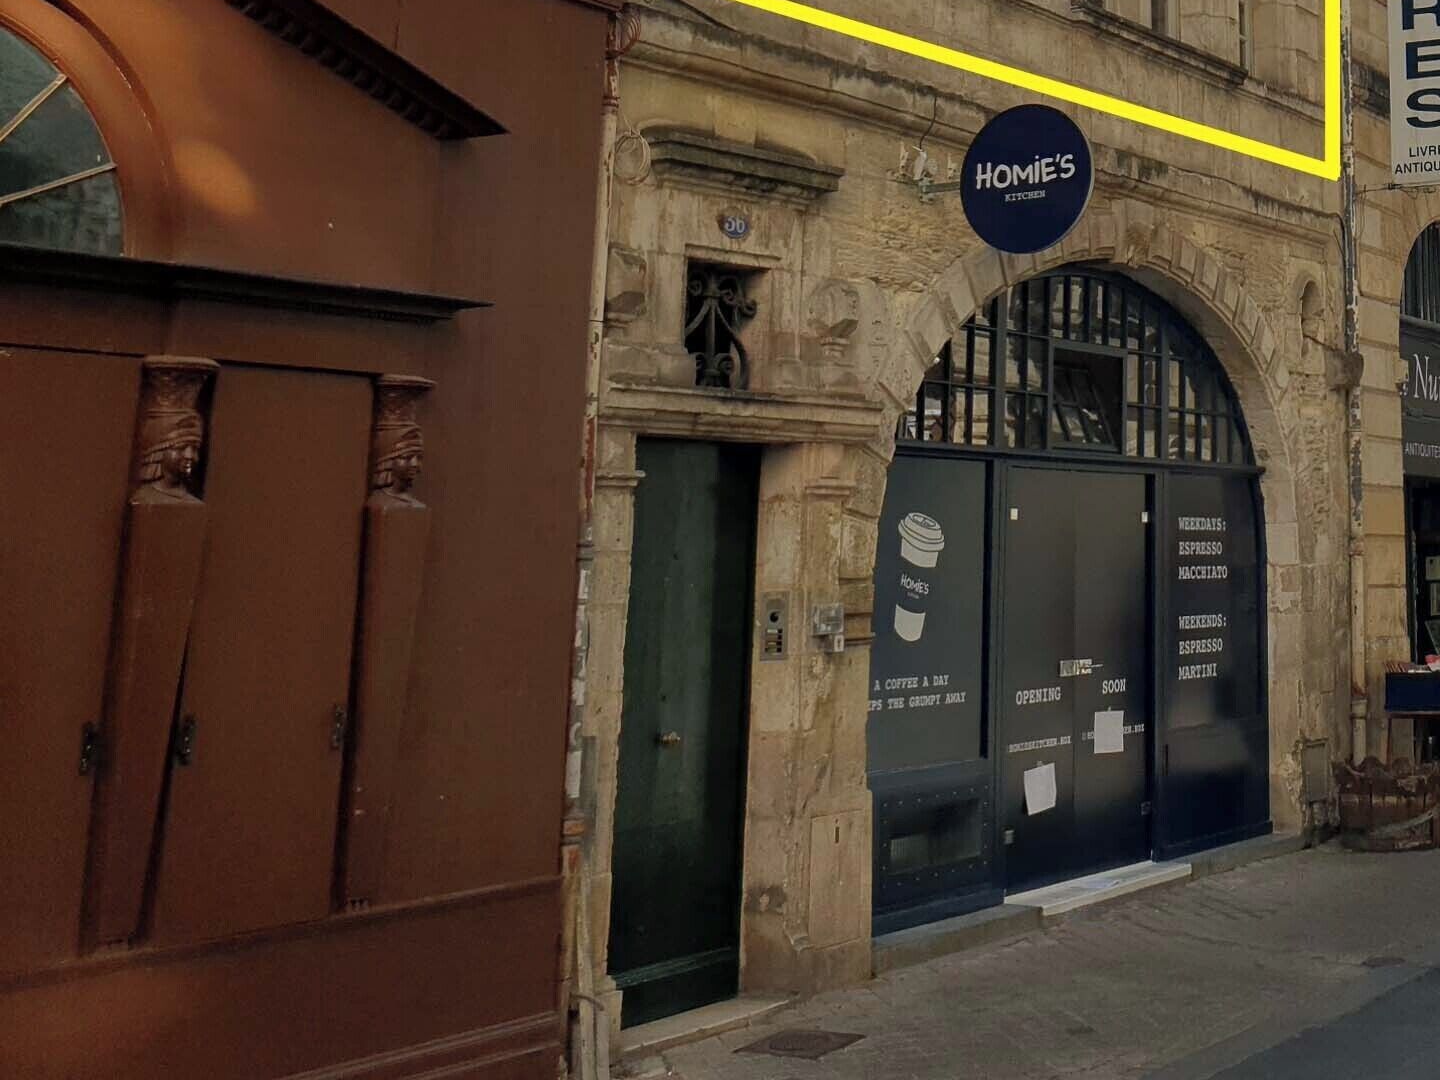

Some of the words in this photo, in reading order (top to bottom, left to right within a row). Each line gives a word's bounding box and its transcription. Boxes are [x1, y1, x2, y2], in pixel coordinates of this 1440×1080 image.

[1004, 190, 1046, 203] KITCHEN
[1178, 517, 1227, 531] WEEKDAYS:
[1178, 541, 1223, 555] ESPRESSO
[1178, 566, 1228, 580] MACCHIATO
[1178, 614, 1227, 630] WEEKENDS:
[1178, 638, 1223, 655] ESPRESSO
[1178, 663, 1218, 680] MARTINI
[874, 679, 881, 691] A
[884, 677, 919, 690] COFFEE
[922, 676, 929, 688] A
[933, 674, 950, 687] DAY
[1015, 686, 1062, 705] OPENING
[1102, 678, 1127, 695] SOON
[887, 697, 905, 710] THE
[909, 694, 941, 708] GRUMPY
[945, 692, 966, 704] AWAY
